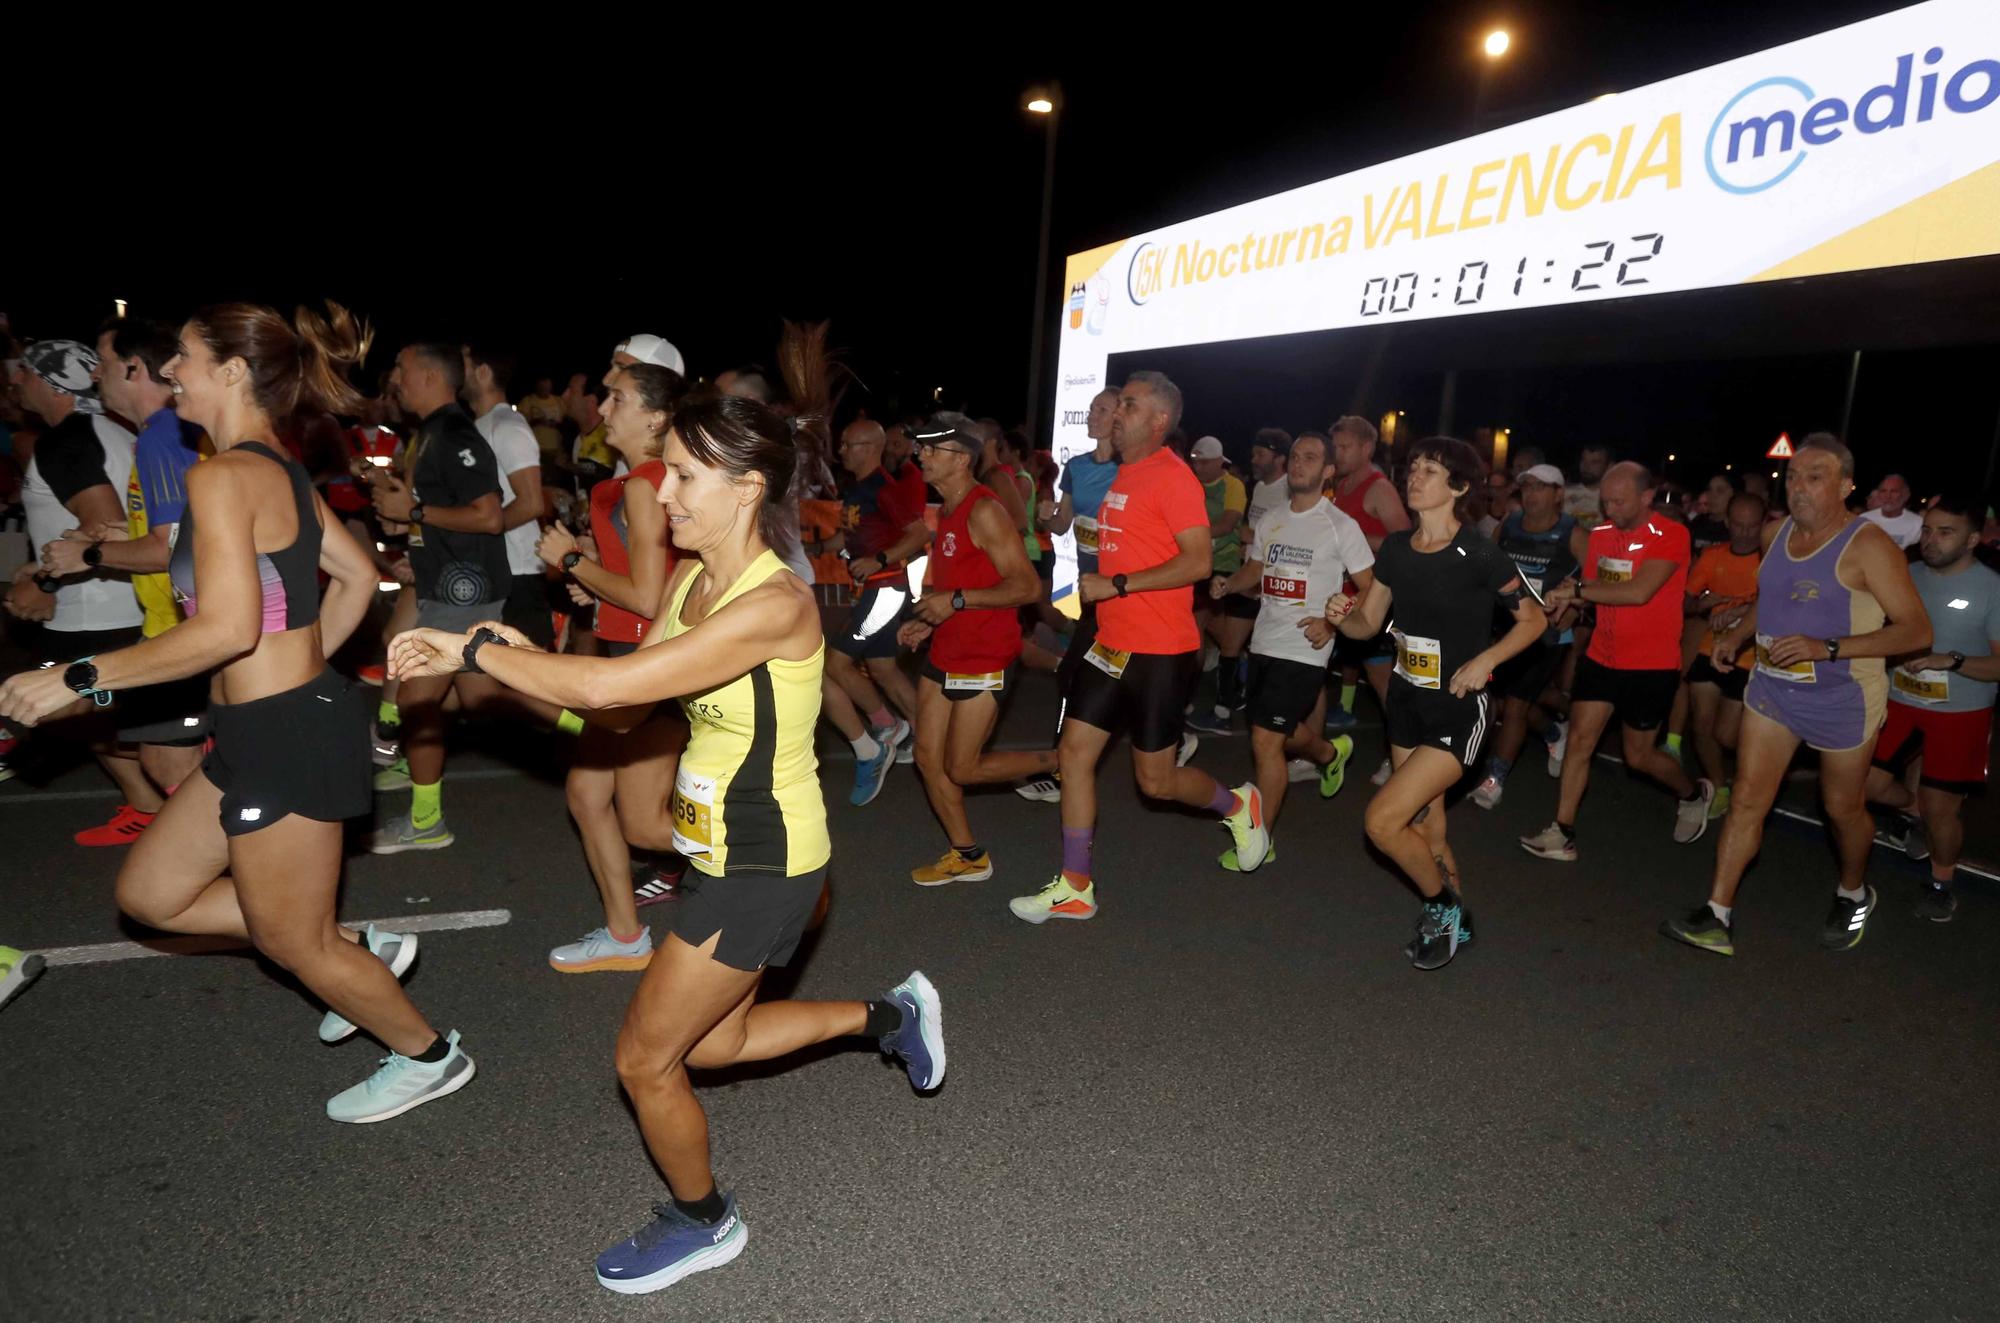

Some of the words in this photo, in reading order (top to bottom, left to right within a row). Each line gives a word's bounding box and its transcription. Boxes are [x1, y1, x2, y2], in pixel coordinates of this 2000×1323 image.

[1726, 46, 2000, 164] medio
[1136, 246, 1168, 297] 15K
[1171, 215, 1353, 288] Nocturna
[1364, 112, 1682, 250] VALENCIA
[1360, 233, 1664, 317] 00:01:22
[1269, 578, 1296, 592] 1306
[689, 701, 724, 718] ERS
[673, 796, 696, 825] 59
[712, 1215, 737, 1244] HOKA
